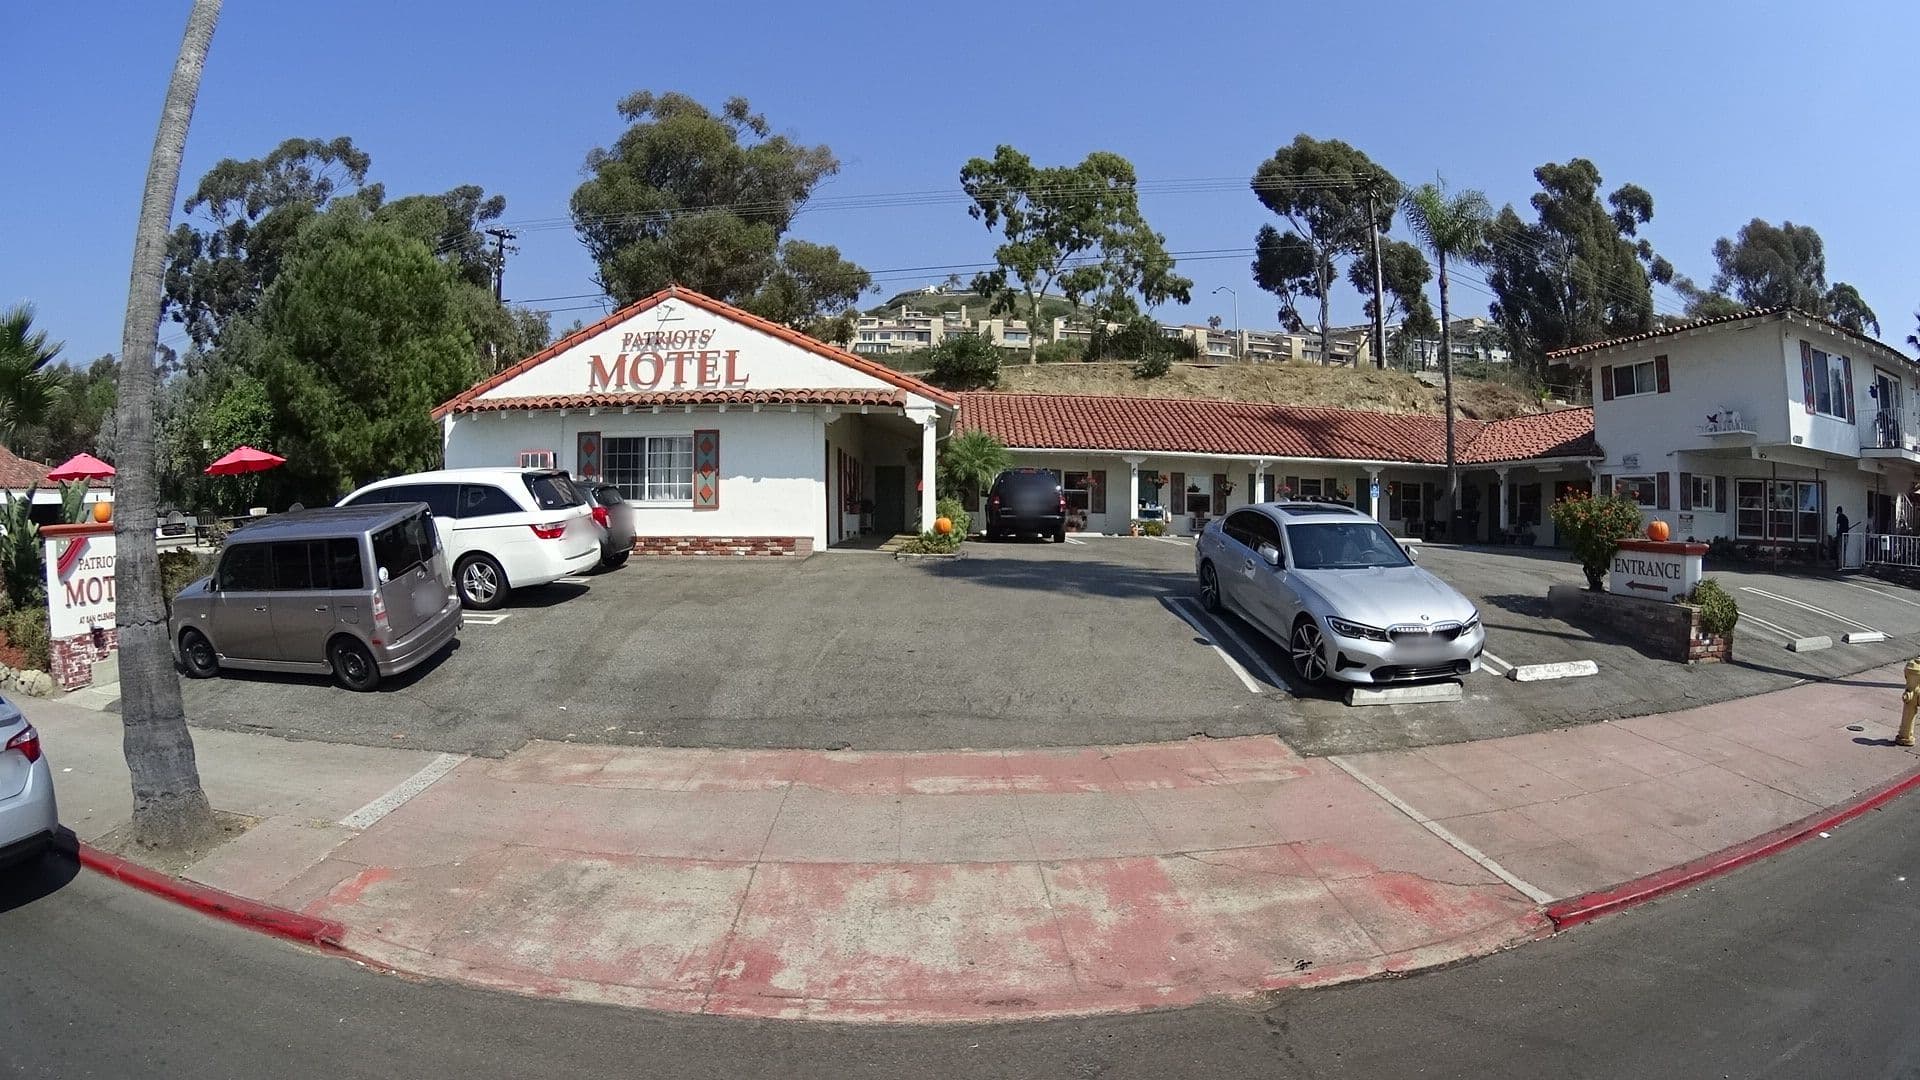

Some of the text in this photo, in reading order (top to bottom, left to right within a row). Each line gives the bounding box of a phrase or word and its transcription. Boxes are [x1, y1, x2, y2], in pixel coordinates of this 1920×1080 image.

[624, 328, 717, 347] PATRIOTS'
[589, 349, 750, 389] MOTEL
[78, 556, 117, 571] PATRIO
[1614, 558, 1681, 580] ENTRANCE
[64, 576, 116, 609] MOT
